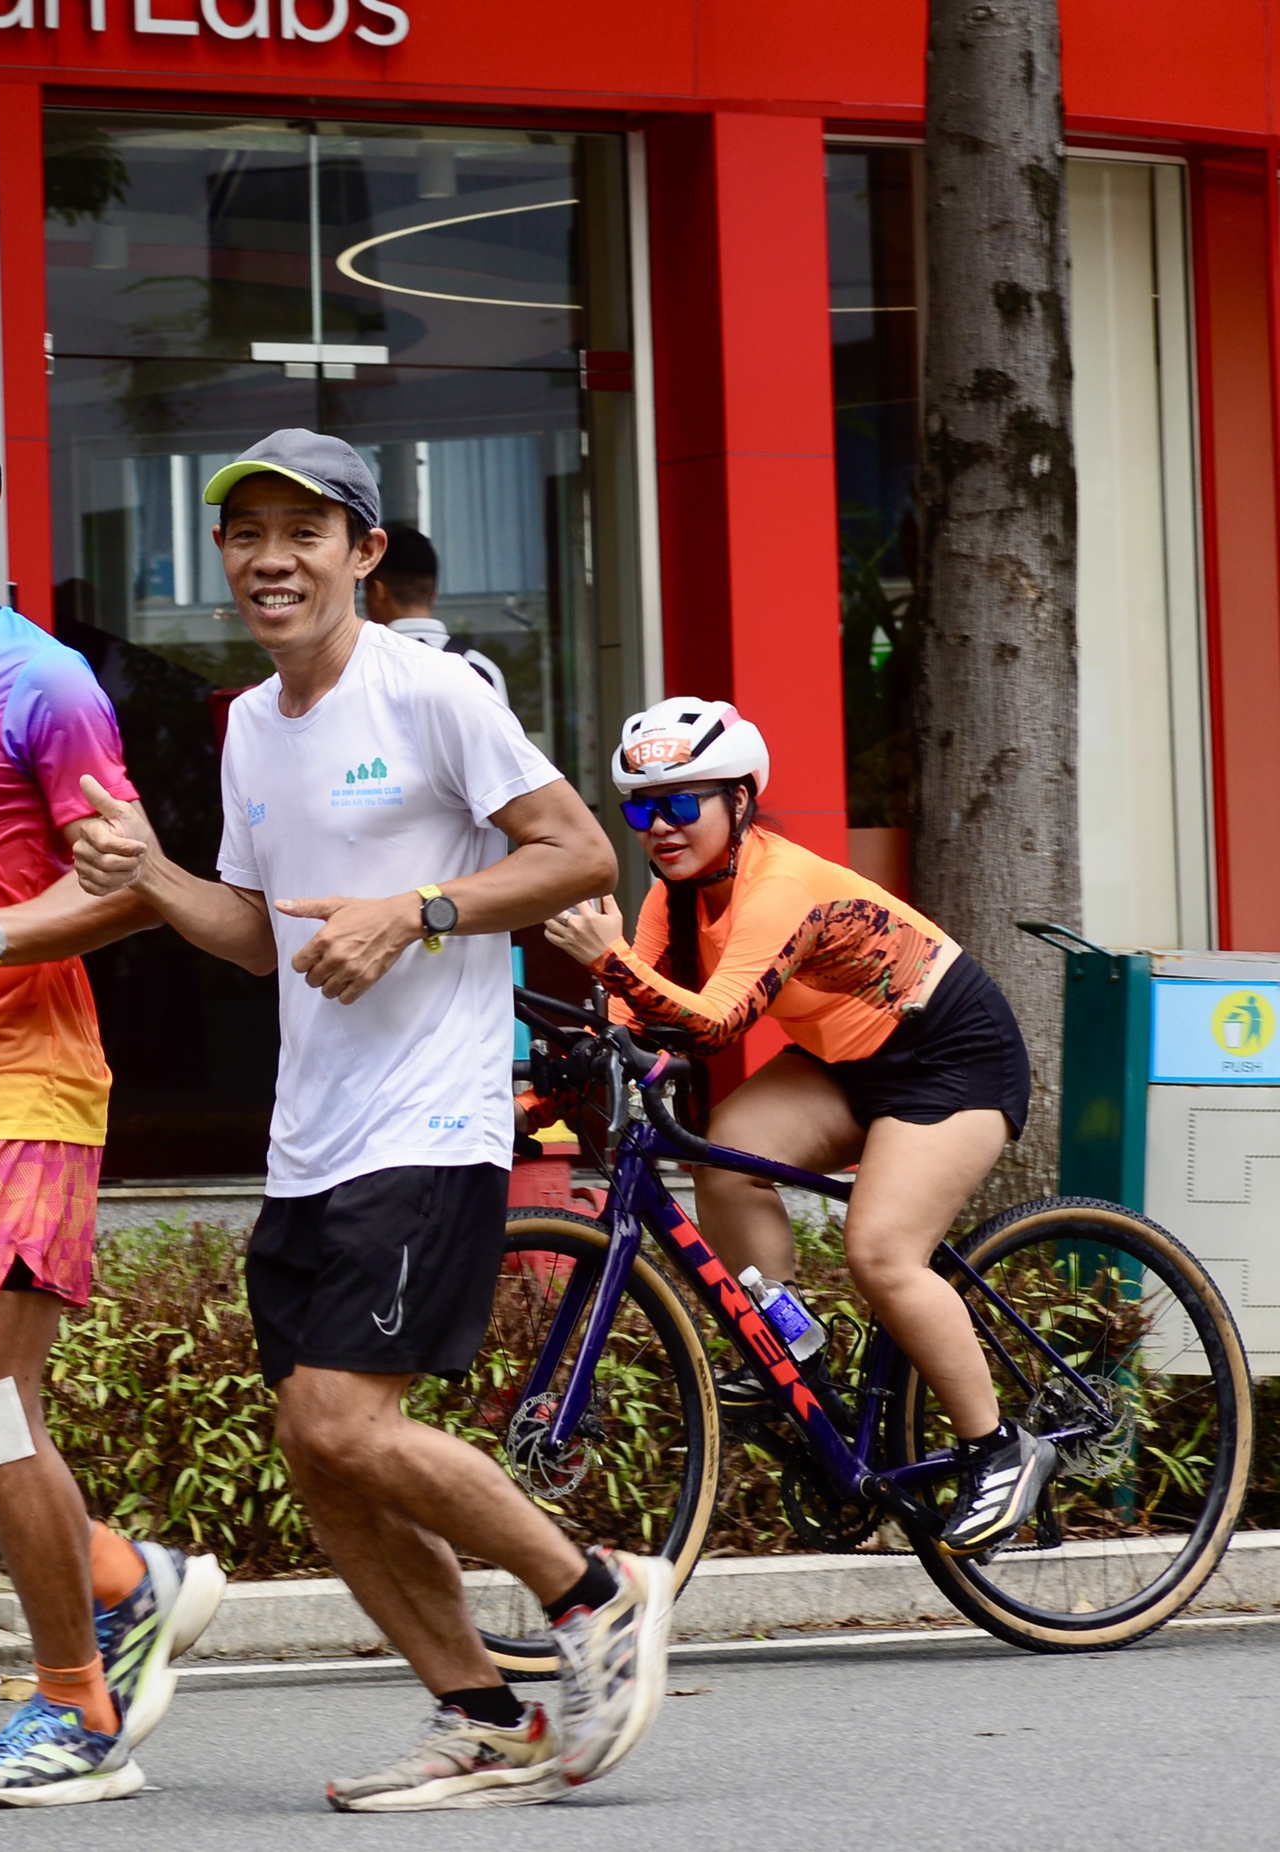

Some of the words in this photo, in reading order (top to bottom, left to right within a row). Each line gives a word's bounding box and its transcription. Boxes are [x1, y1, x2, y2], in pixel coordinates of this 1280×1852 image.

[632, 740, 679, 764] 1367
[384, 786, 402, 795] CLUB
[428, 1115, 468, 1129] GDC
[670, 1201, 822, 1422] TREK
